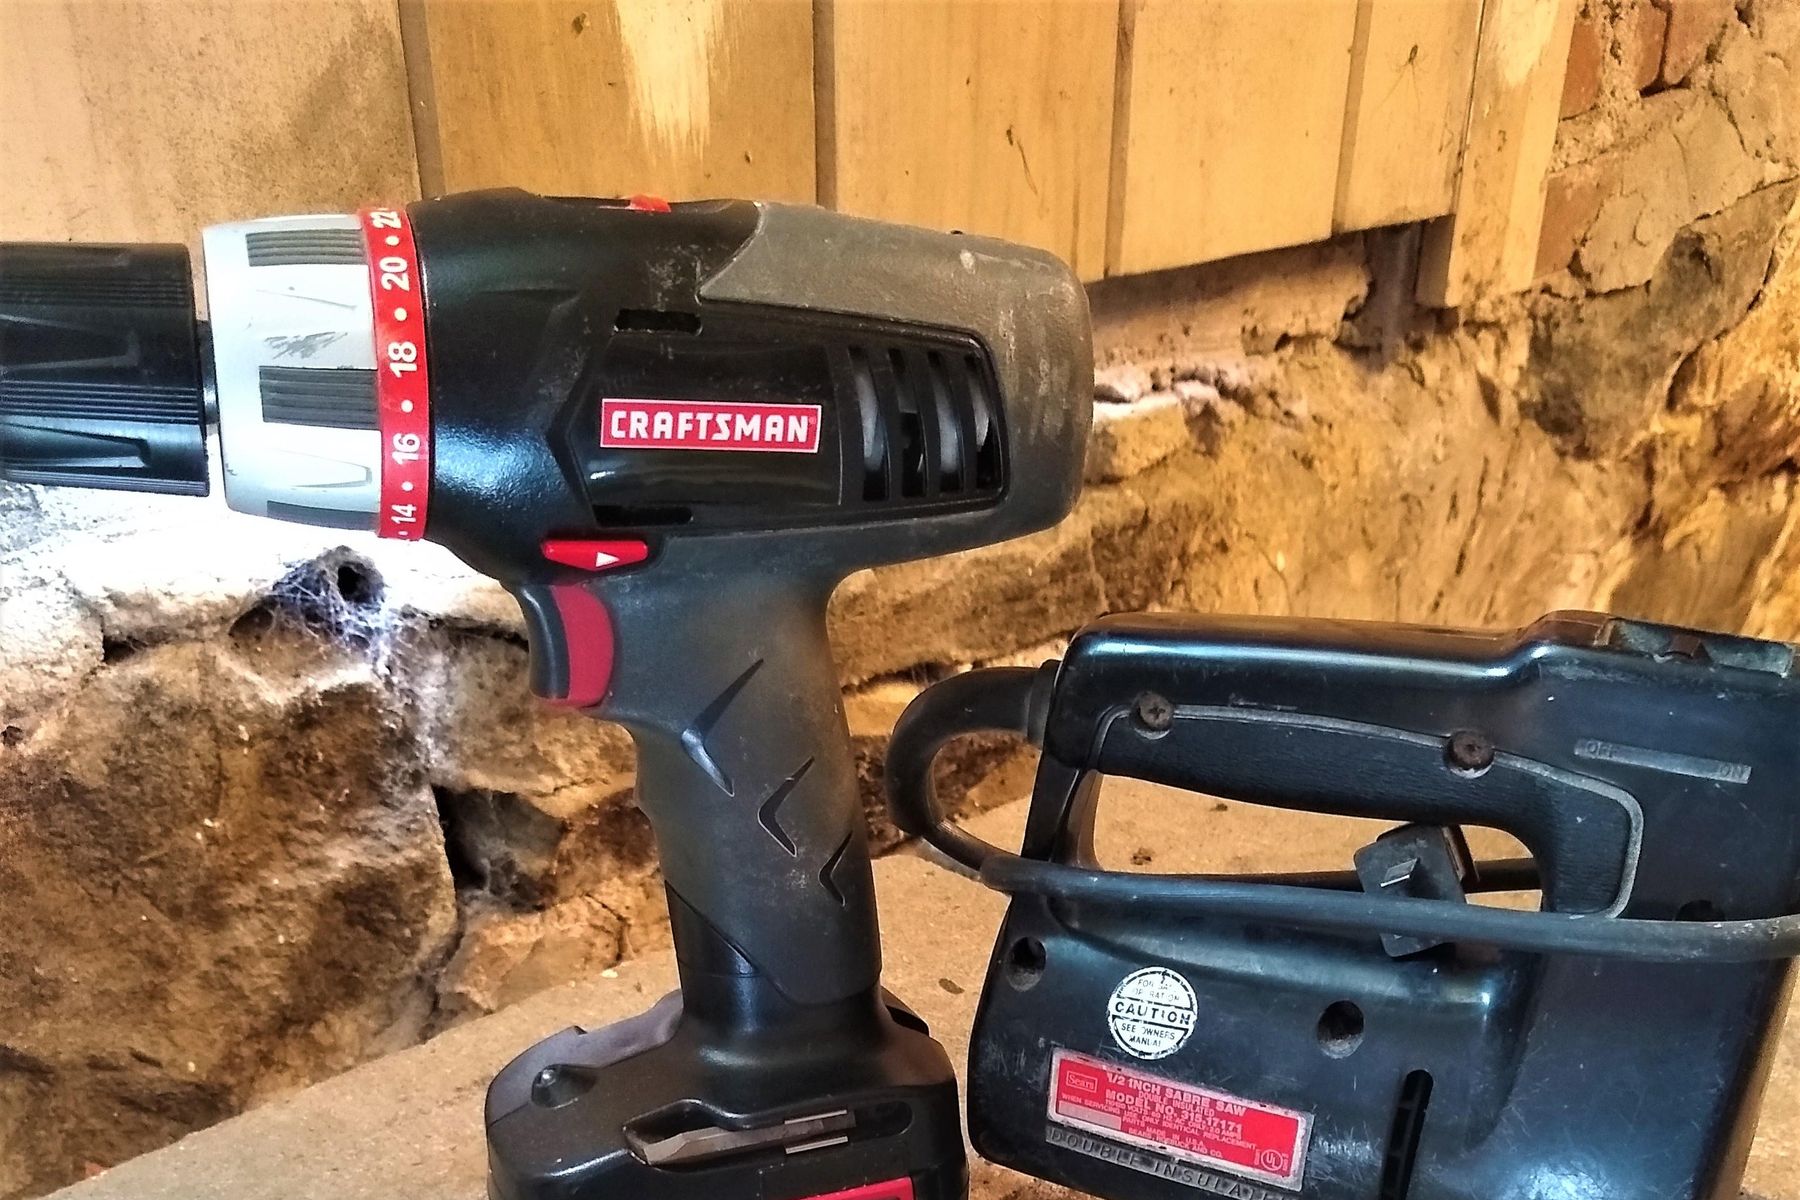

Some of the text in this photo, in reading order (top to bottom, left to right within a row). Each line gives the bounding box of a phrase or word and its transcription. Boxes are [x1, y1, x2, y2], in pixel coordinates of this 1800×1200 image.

[379, 256, 410, 291] 20
[387, 340, 418, 378] 18
[610, 410, 809, 443] CRAFTSMAN
[391, 432, 421, 464] 16
[390, 503, 417, 524] 14
[1718, 763, 1745, 779] ON
[1115, 1001, 1191, 1025] CAUTION
[1121, 1022, 1136, 1033] SEE
[1069, 1074, 1095, 1091] Sears
[1128, 1078, 1160, 1096] INCH
[1165, 1088, 1210, 1108] SABRE
[1216, 1101, 1247, 1117] SAW
[1105, 1088, 1243, 1134] MODEL NO. 315.17171
[1138, 1090, 1215, 1117] DOUBLE INSULATED
[1051, 1127, 1144, 1167] DOUBLE
